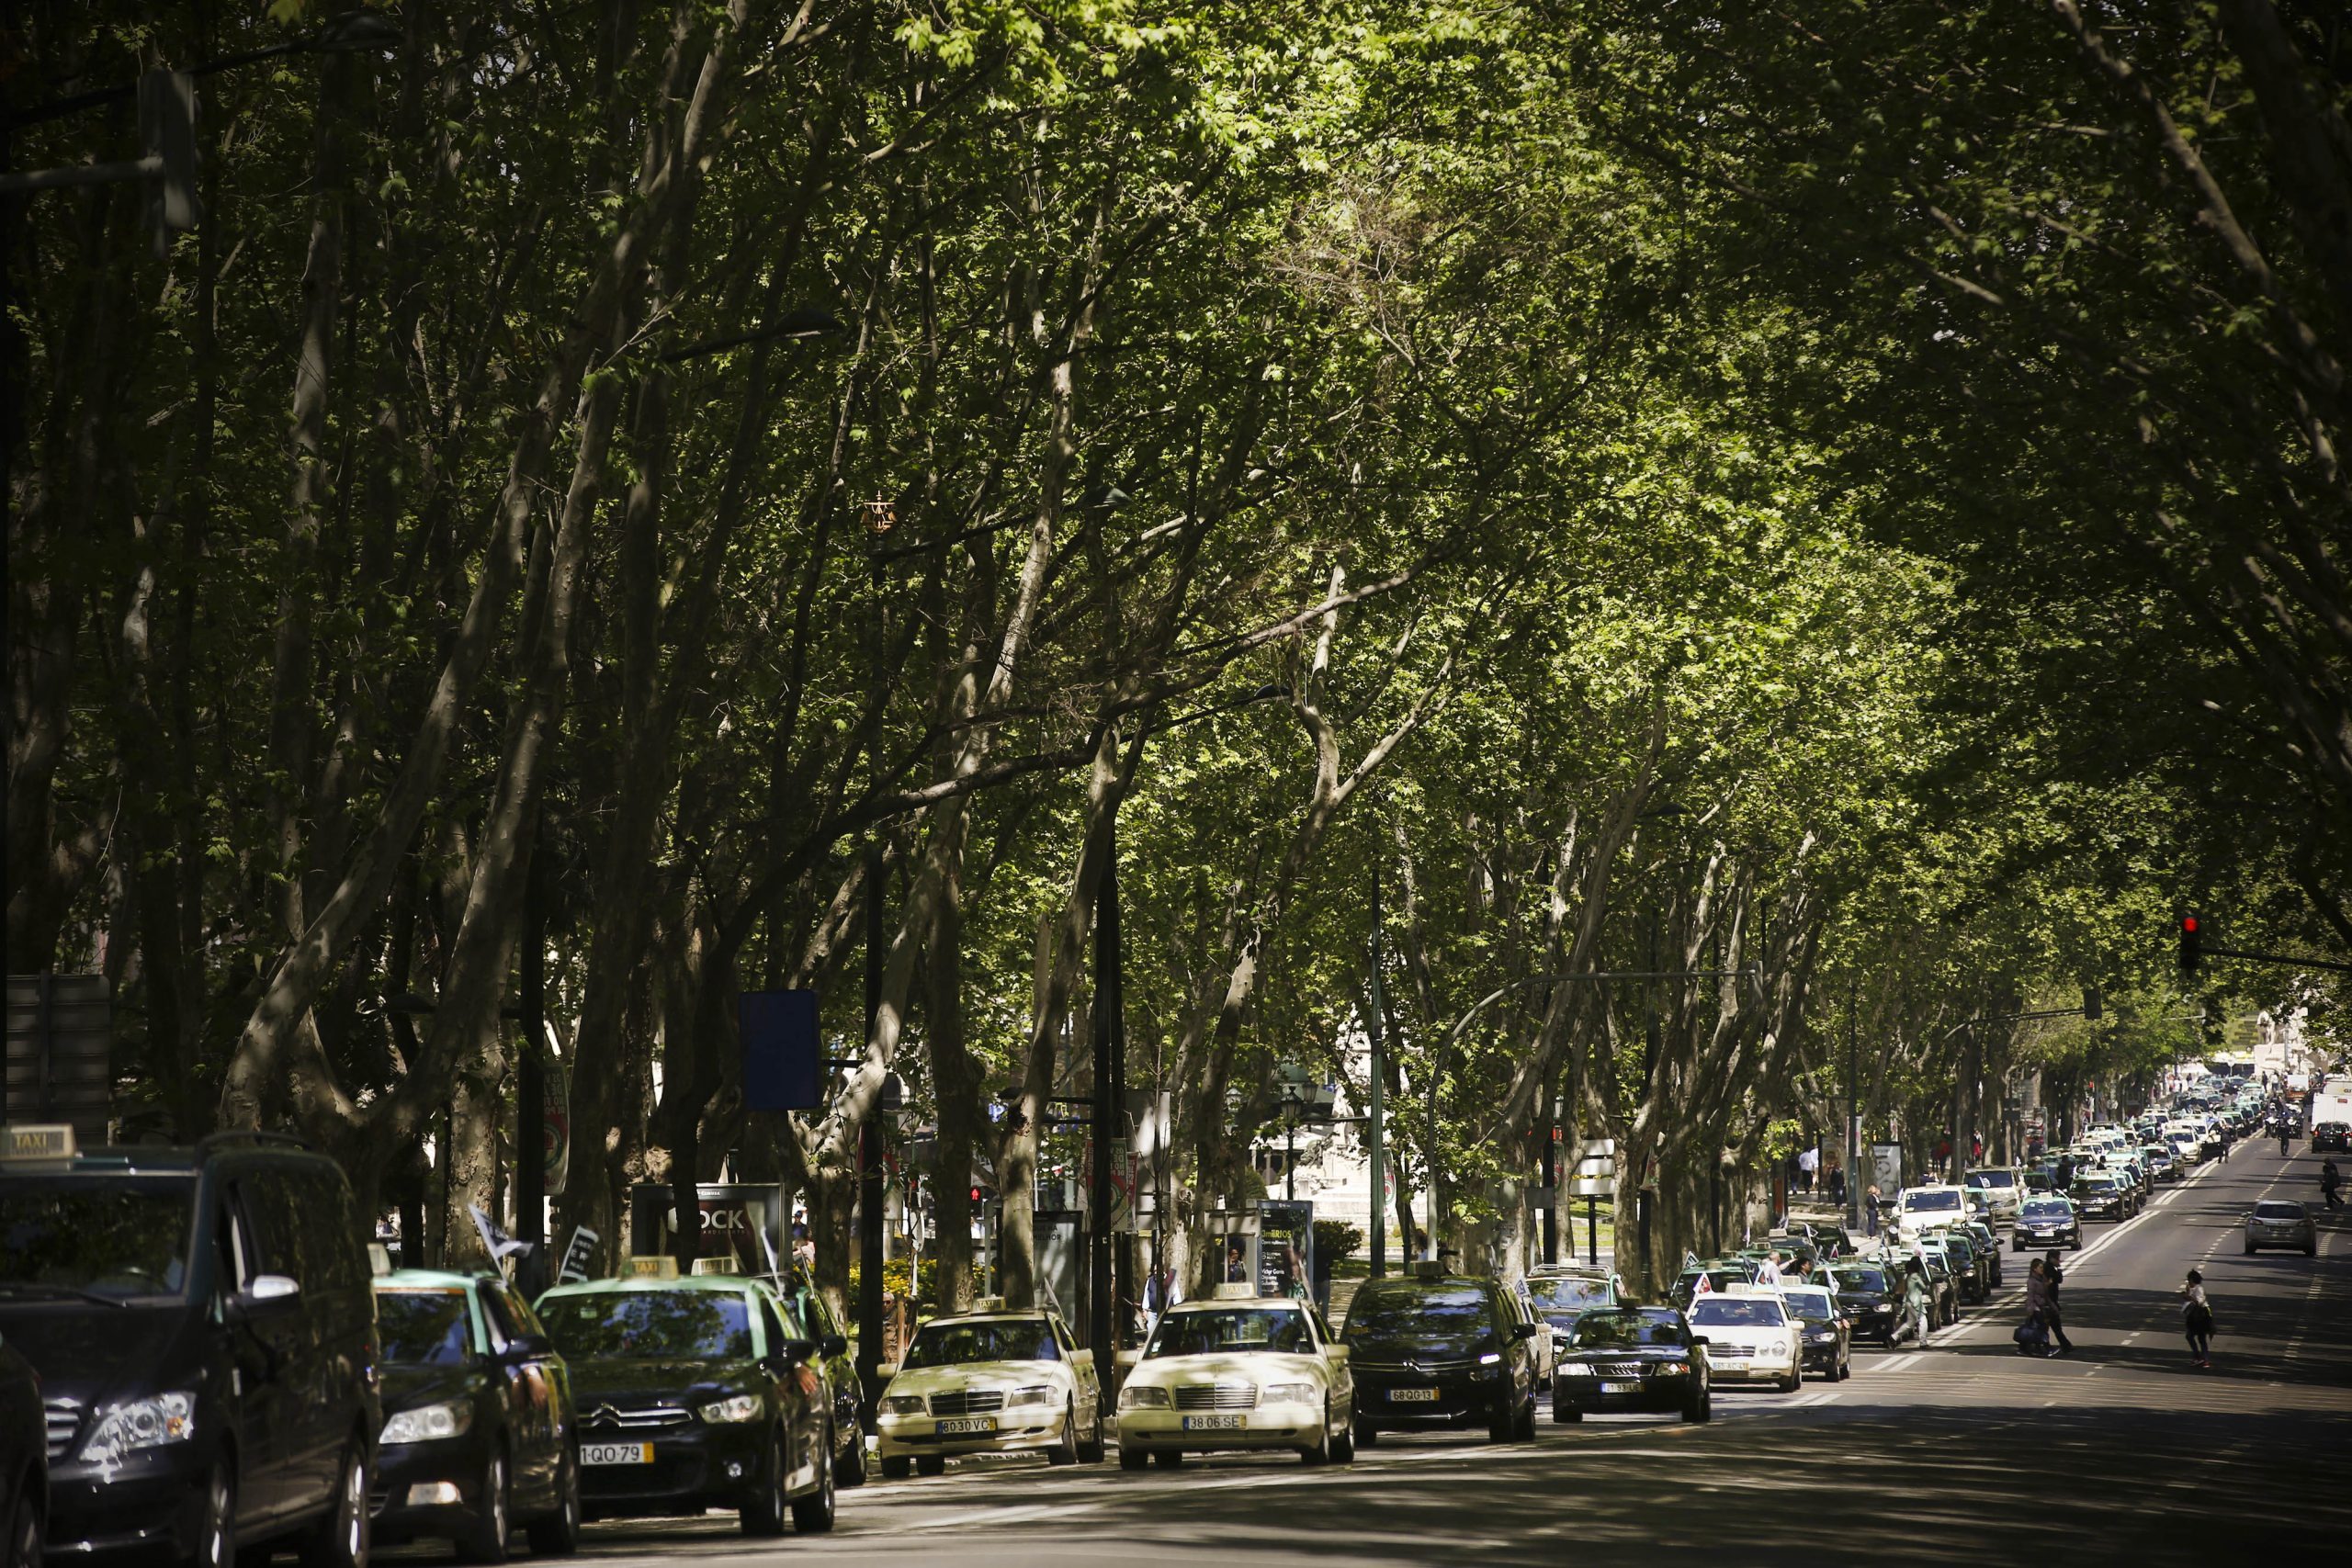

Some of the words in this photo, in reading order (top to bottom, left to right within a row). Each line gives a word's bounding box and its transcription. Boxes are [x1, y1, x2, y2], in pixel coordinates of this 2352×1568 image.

[15, 1132, 48, 1148] TAXI
[633, 1261, 658, 1273] TAXI
[1225, 1286, 1242, 1294] TAXI
[978, 1300, 993, 1308] TAXI
